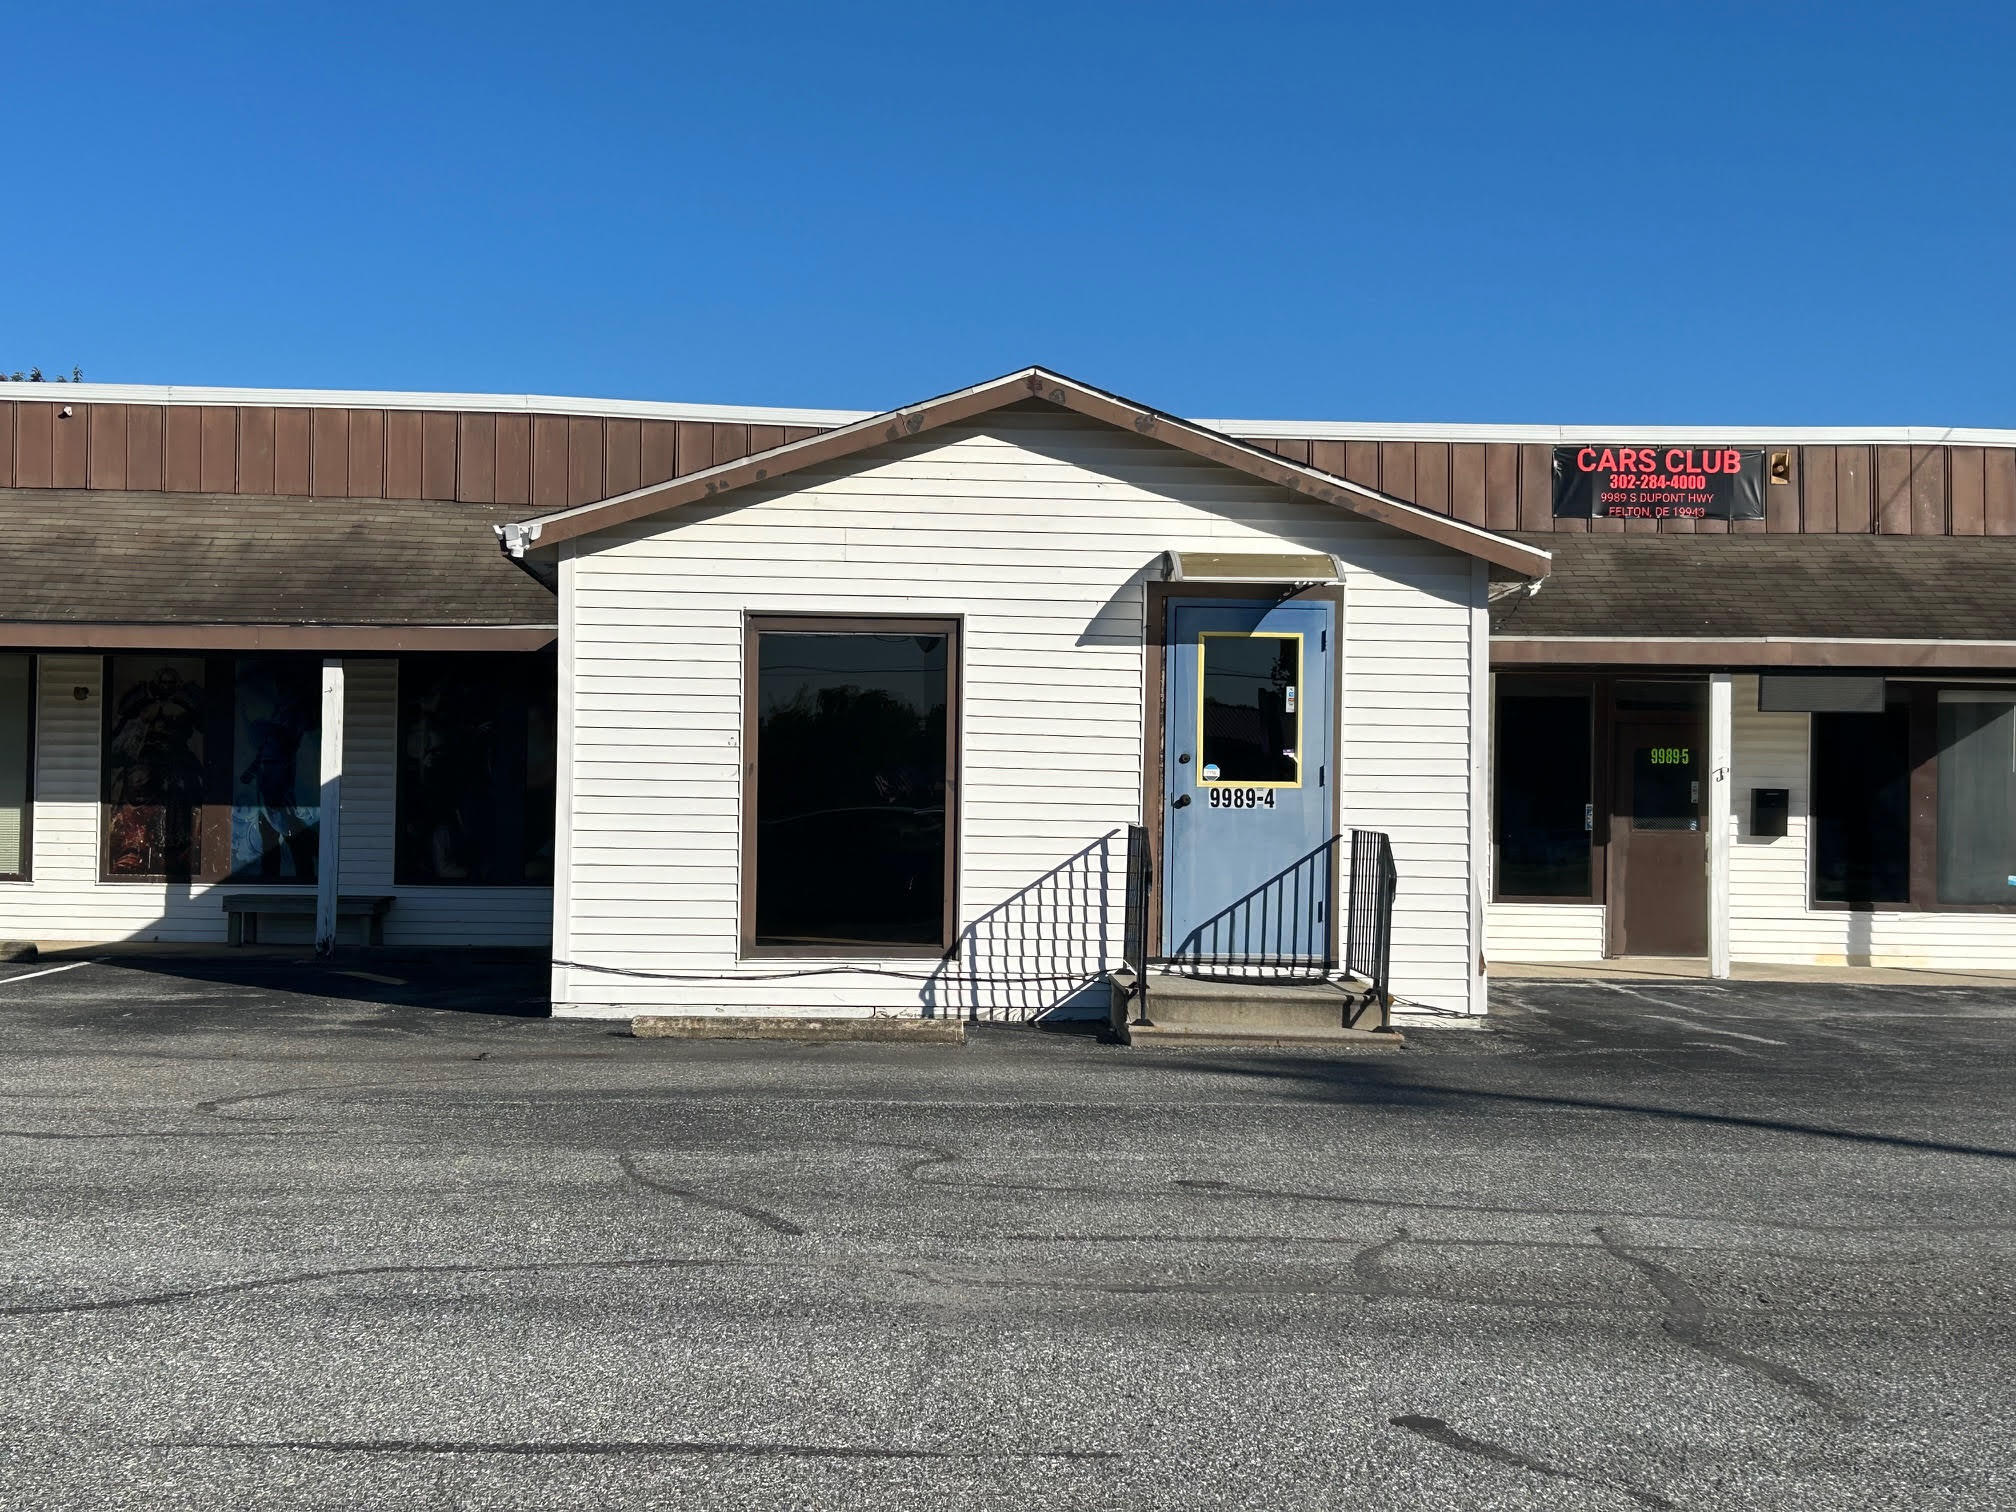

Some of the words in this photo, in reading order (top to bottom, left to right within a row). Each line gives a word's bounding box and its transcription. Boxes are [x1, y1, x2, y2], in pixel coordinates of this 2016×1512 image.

[1577, 449, 1656, 472] CARS
[1666, 450, 1741, 474] CLUB
[1609, 475, 1706, 490] 302-284-4000
[1600, 492, 1627, 503] 9989
[1630, 492, 1637, 503] S
[1640, 493, 1685, 503] DUPONT
[1689, 493, 1714, 503] HWY
[1609, 506, 1652, 518] FELTON,
[1655, 507, 1670, 516] DE
[1673, 507, 1705, 517] 19943
[1210, 788, 1275, 809] 9989-4
